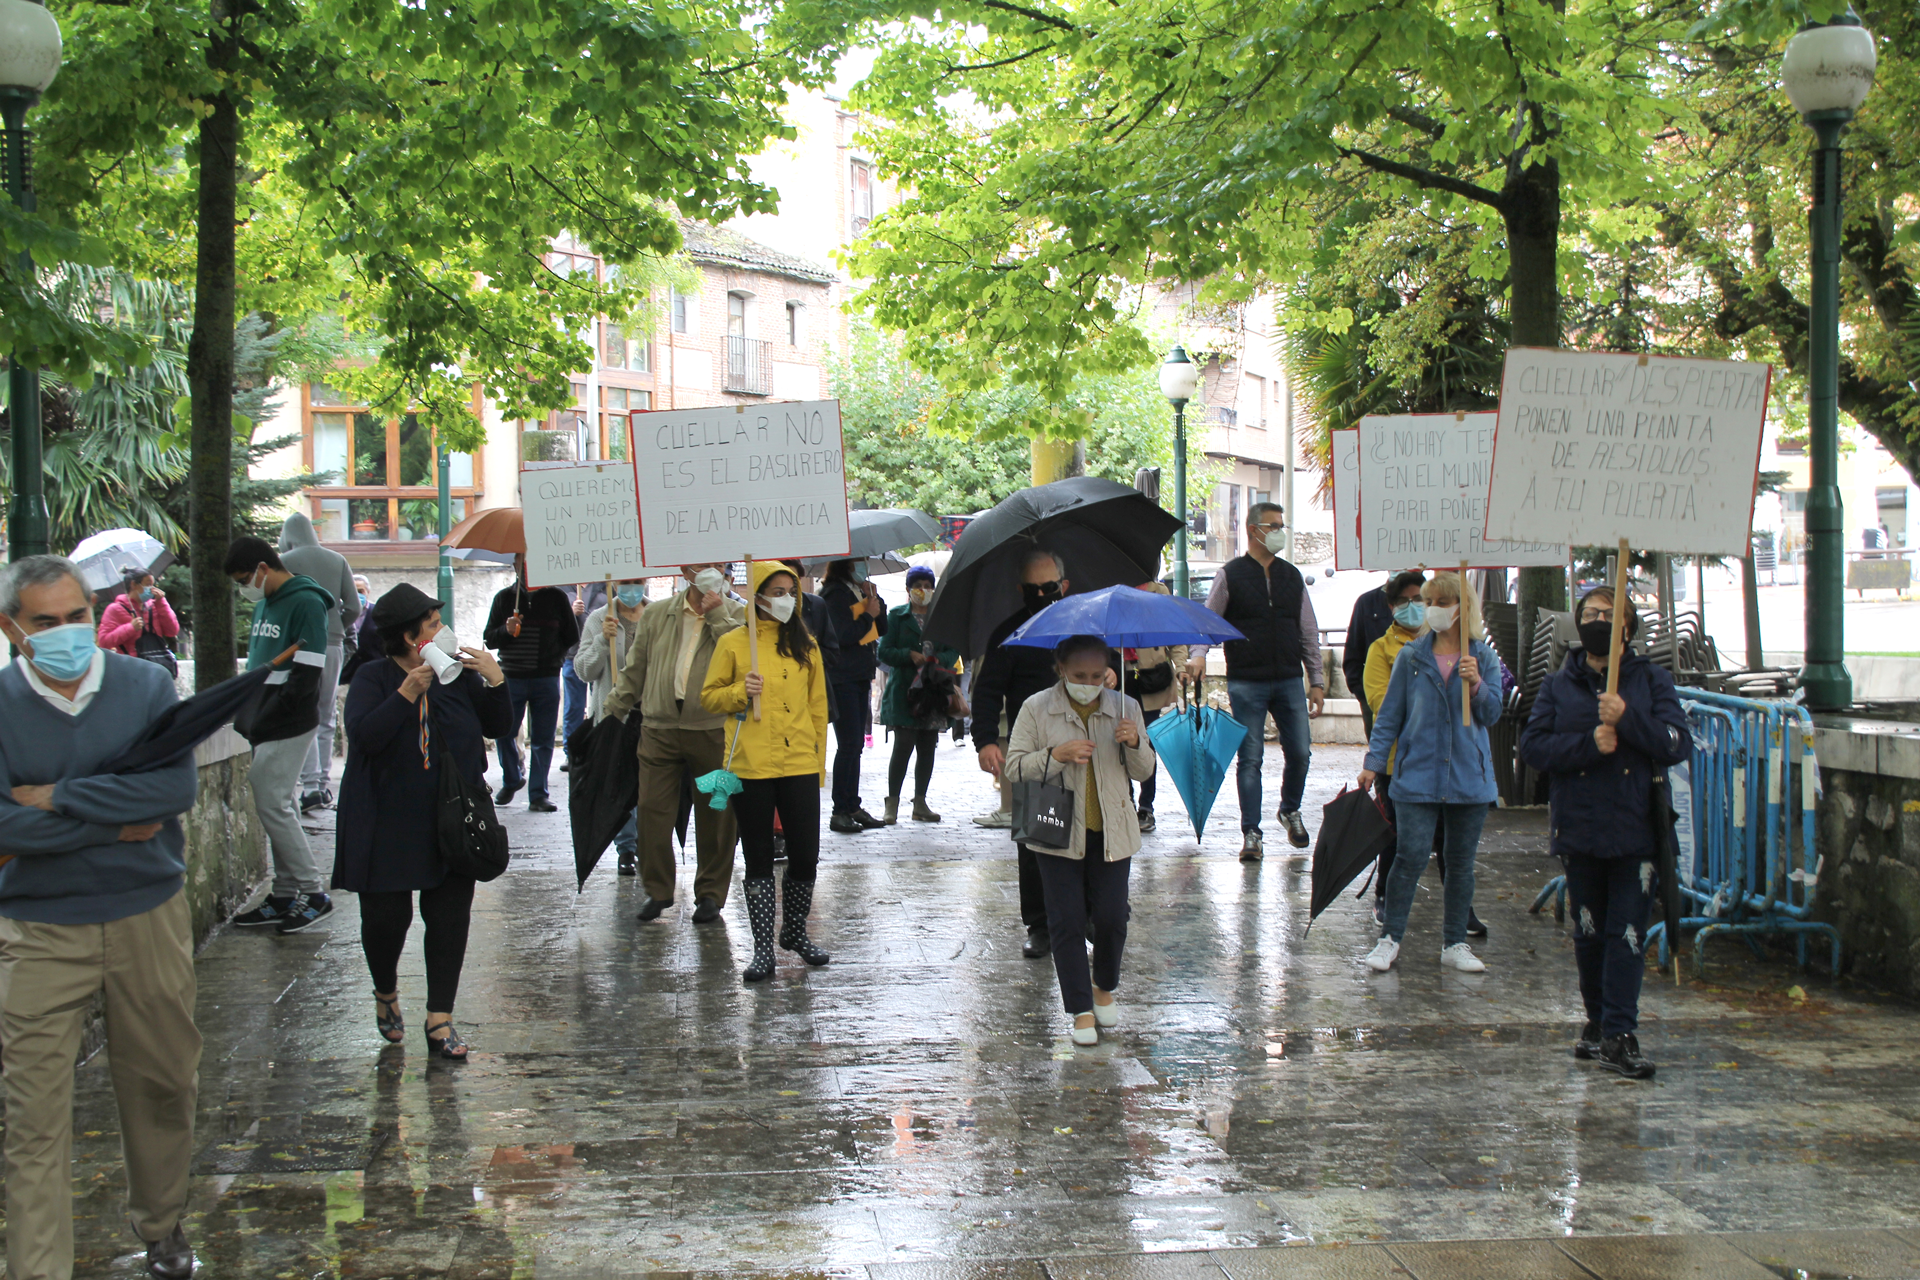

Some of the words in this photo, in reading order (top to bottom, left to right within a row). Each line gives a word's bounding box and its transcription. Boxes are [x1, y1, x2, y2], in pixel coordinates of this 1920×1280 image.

[1518, 365, 1615, 397] CUELLAR
[655, 416, 770, 450] CUELLAR
[785, 409, 825, 447] NO
[1514, 403, 1572, 434] PONEN
[1585, 409, 1625, 437] UNA
[1633, 411, 1713, 443] PLANTA
[661, 460, 696, 489] ES
[711, 457, 739, 486] EL
[748, 449, 842, 482] BASURERO
[1551, 440, 1579, 467] DE
[1588, 441, 1711, 475] RESIDUOS
[545, 505, 572, 521] UN
[1381, 498, 1429, 523] PARA
[1520, 475, 1537, 510] A
[1551, 476, 1586, 511] TU
[1601, 479, 1697, 522] PUERTA
[666, 509, 689, 535] DE
[697, 508, 719, 533] LA
[727, 502, 831, 530] PROVINCIA
[545, 525, 567, 547] NO
[1376, 527, 1437, 555] PLANTA
[1443, 528, 1462, 553] DE
[546, 551, 580, 571] PARA
[1037, 813, 1065, 829] nemba
